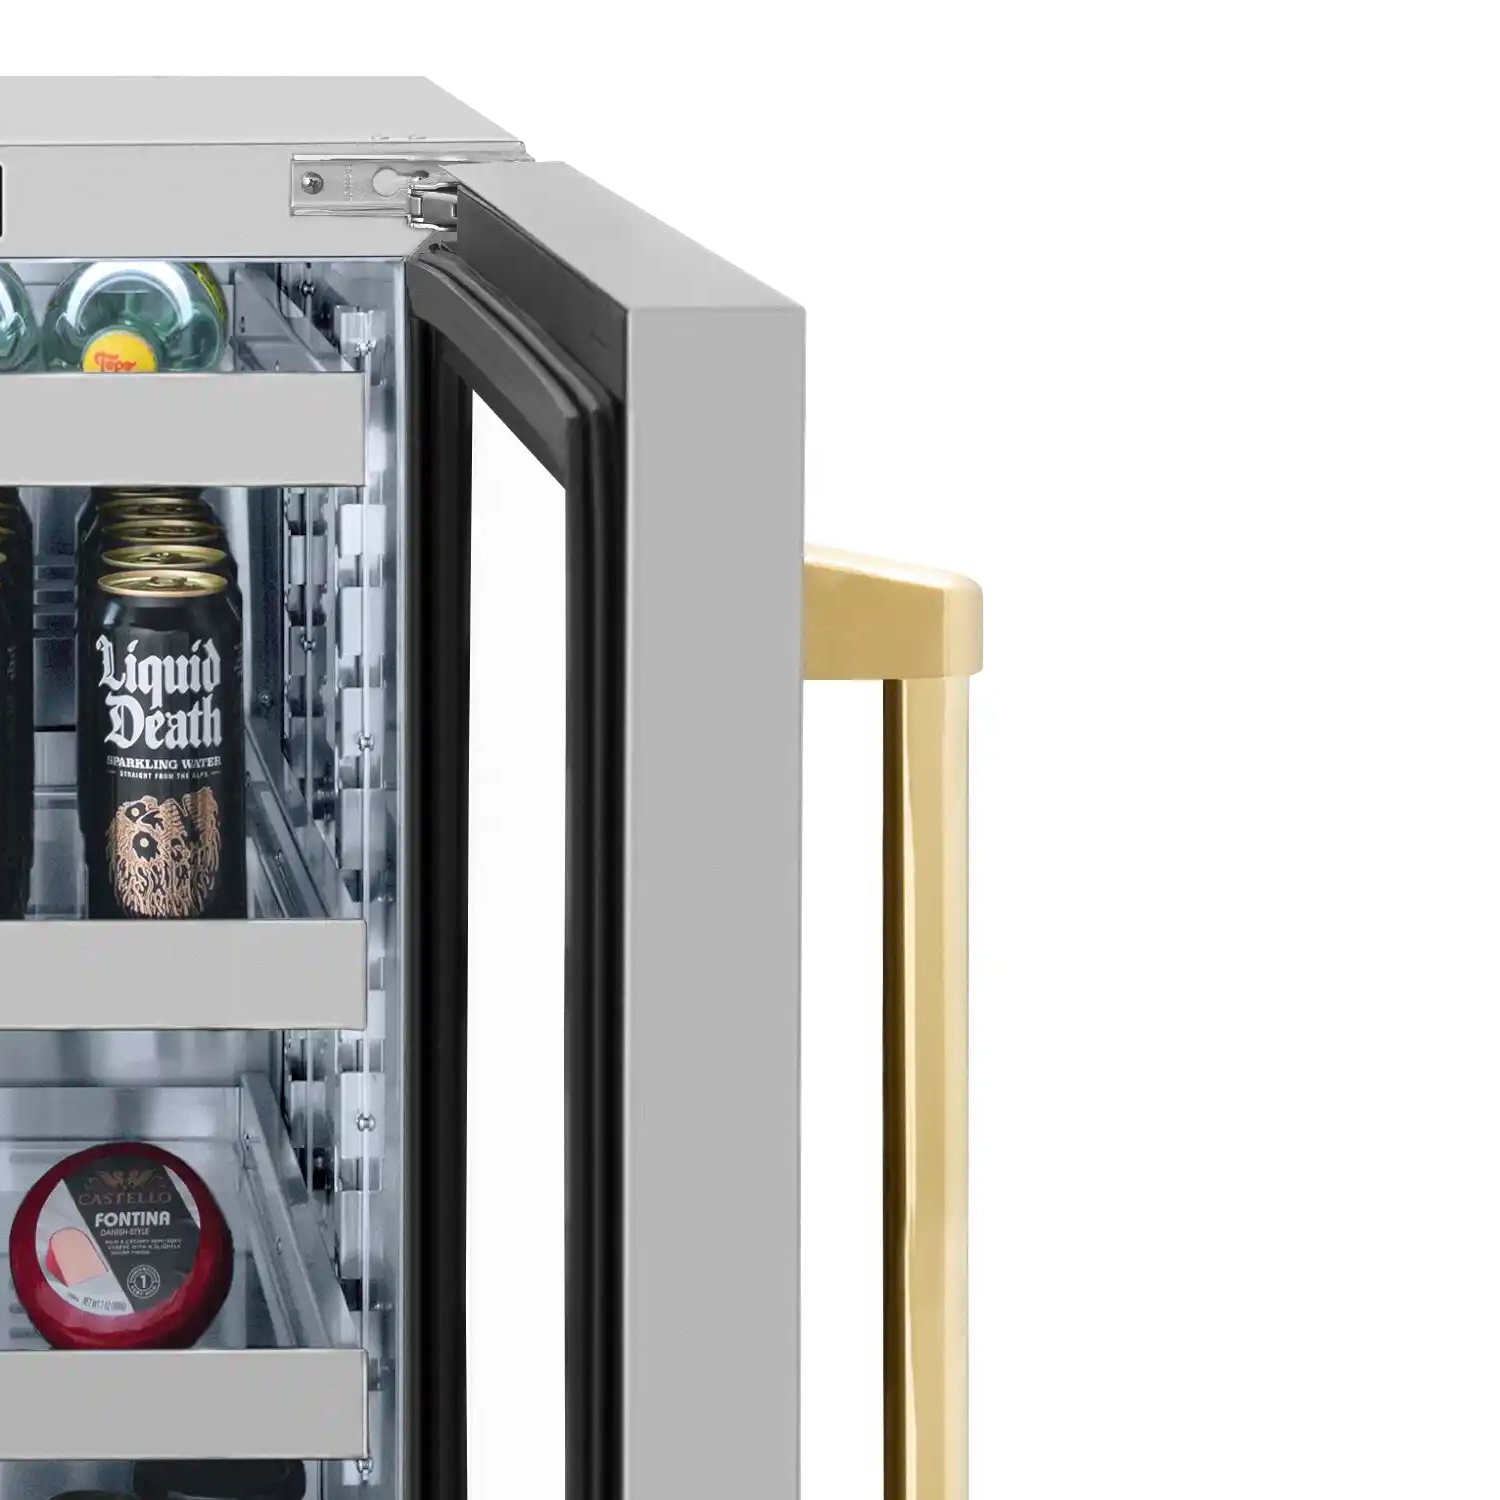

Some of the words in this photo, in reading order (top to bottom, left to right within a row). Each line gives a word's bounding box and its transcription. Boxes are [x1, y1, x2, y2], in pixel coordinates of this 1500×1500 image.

[96, 633, 221, 711] Liquid
[104, 692, 222, 750] Death
[106, 755, 178, 770] SPARKLING
[181, 755, 221, 769] WATER
[78, 1191, 173, 1206] CASTELLO
[95, 1210, 172, 1228] FONTINA
